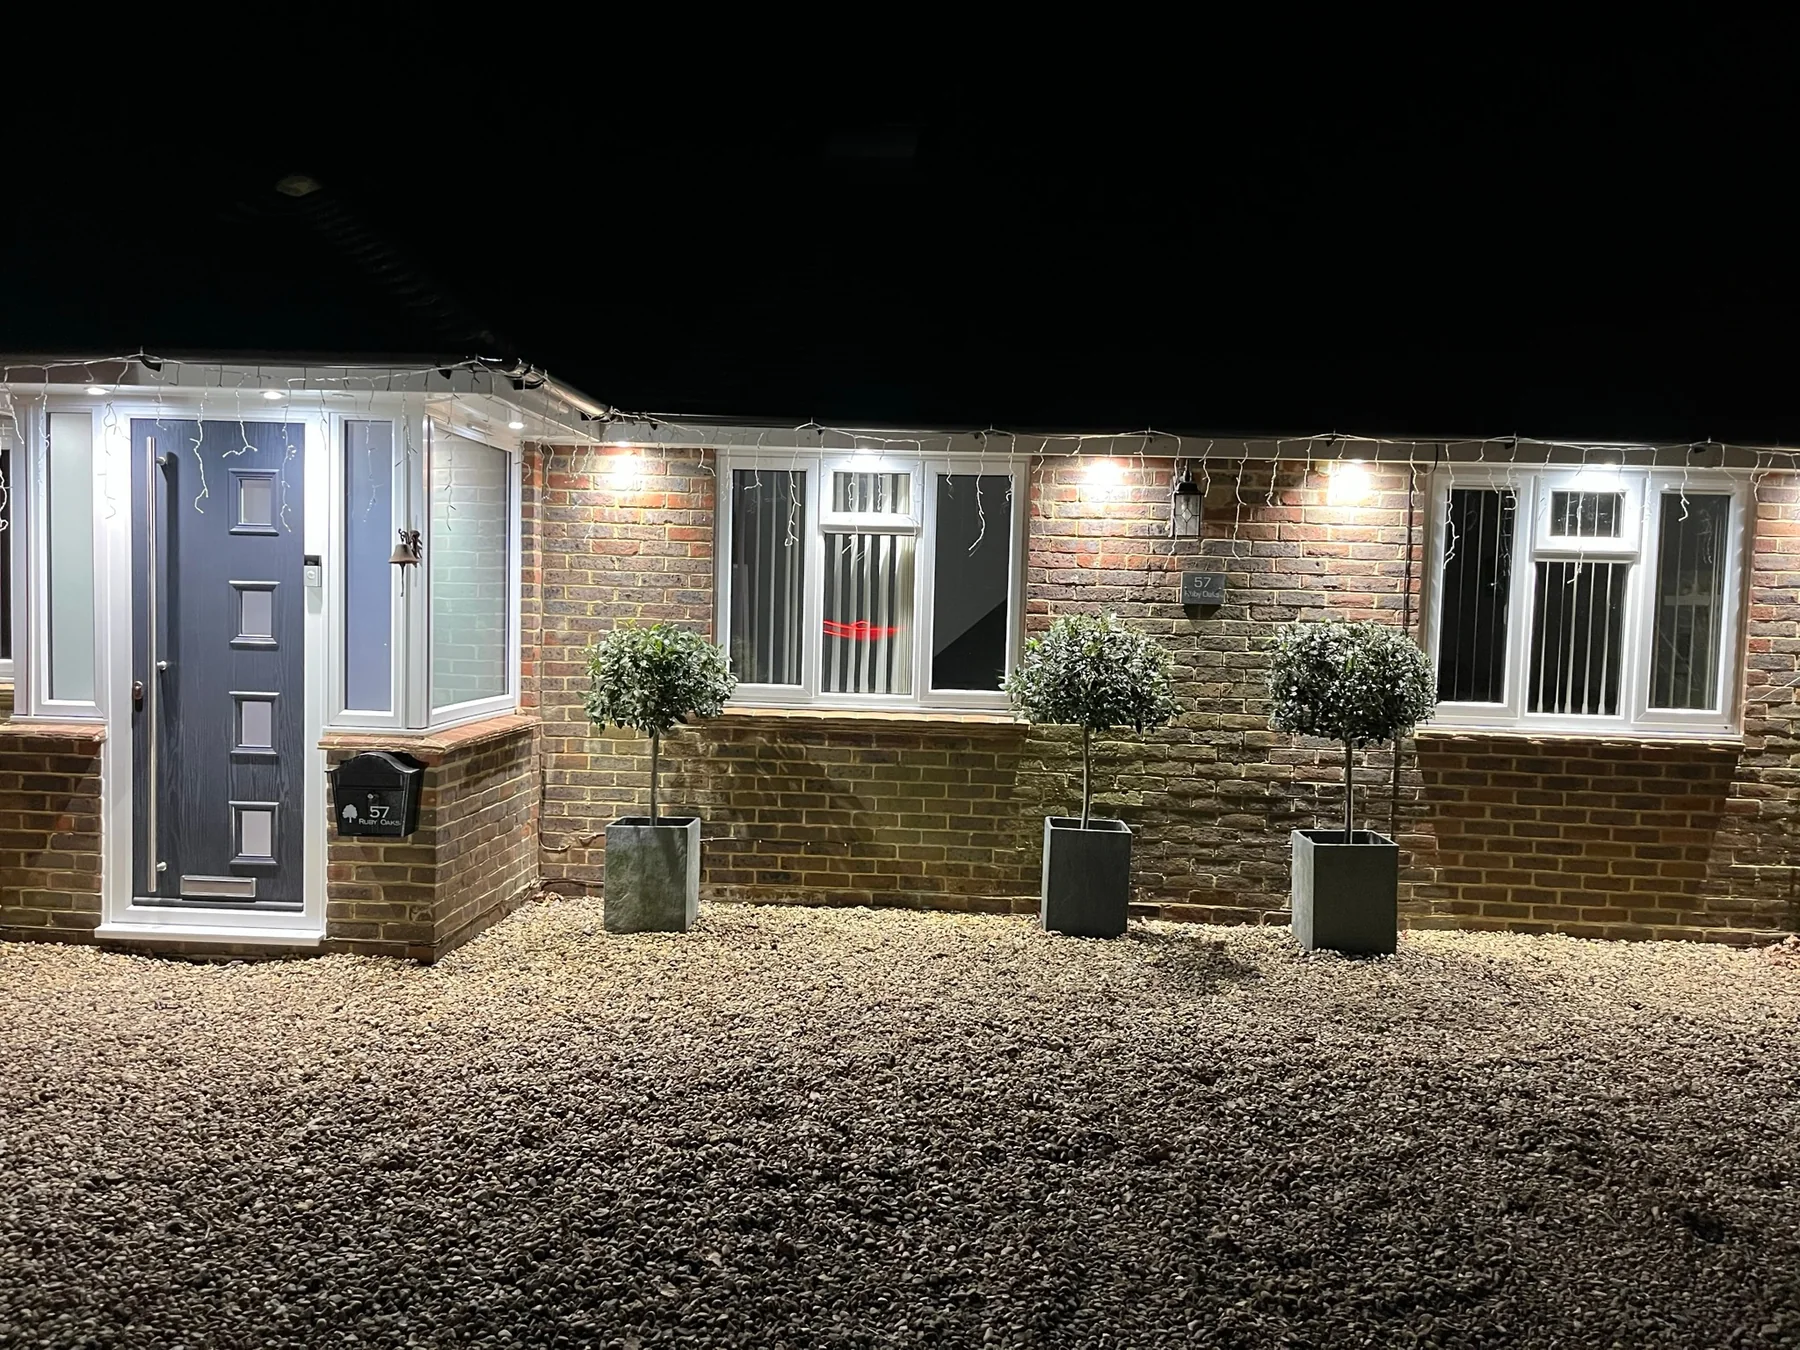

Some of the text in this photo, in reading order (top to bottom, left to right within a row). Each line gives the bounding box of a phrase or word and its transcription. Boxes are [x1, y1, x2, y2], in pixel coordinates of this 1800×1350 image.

[1194, 577, 1211, 588] 57
[1184, 590, 1201, 598] Ruby
[369, 805, 390, 818] 57
